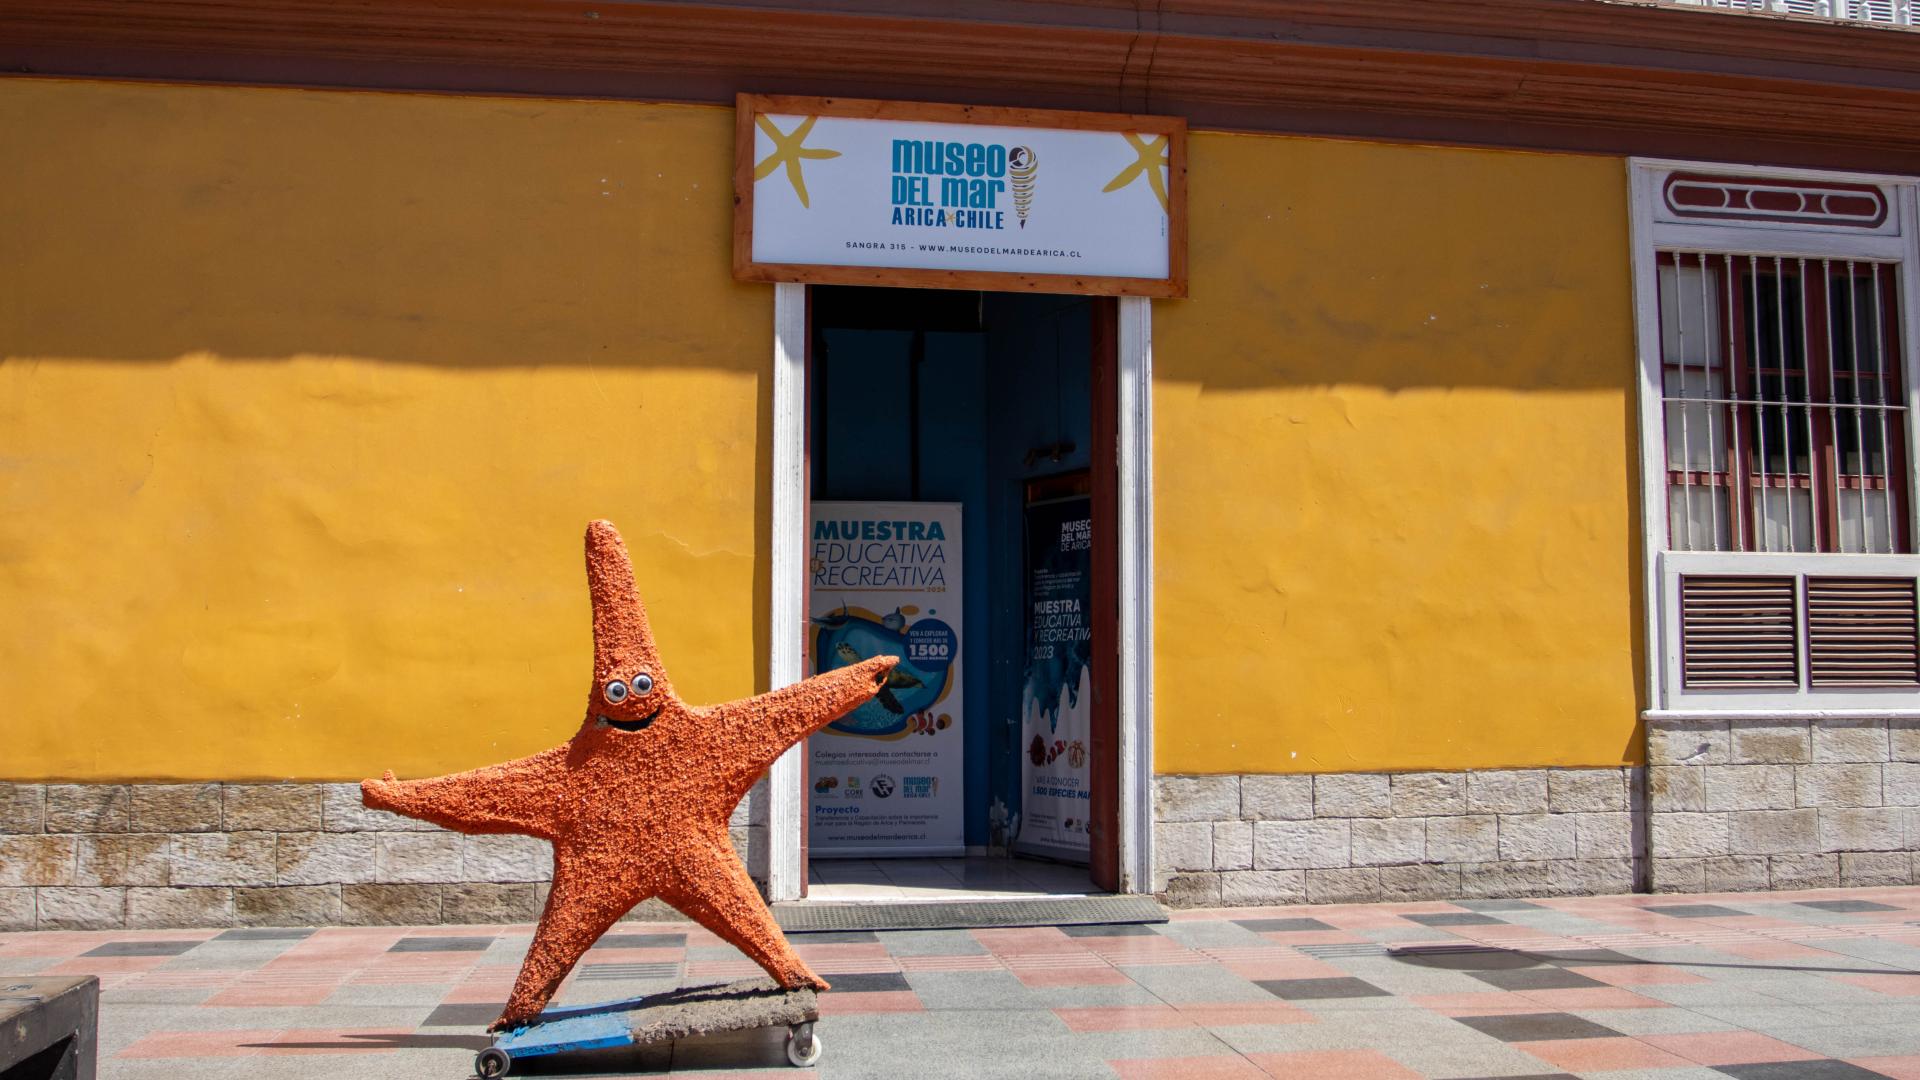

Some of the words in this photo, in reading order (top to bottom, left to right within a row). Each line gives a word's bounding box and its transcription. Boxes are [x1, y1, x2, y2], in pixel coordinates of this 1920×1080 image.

[893, 139, 1006, 178] museo
[892, 176, 934, 206] DEL
[941, 177, 1004, 208] mar
[892, 207, 947, 227] ARICA
[955, 210, 1004, 230] CHILE
[845, 241, 885, 250] SANGRA
[890, 243, 906, 251] 315
[919, 244, 1083, 258] WWW.MUSEODELMARDEARICA.CL
[814, 520, 946, 541] MUESTRA
[1061, 532, 1075, 543] DEL
[815, 543, 946, 564] EDUCATIVA
[1060, 542, 1070, 552] DE
[814, 566, 946, 586] RECREATIVA
[1034, 599, 1081, 615] MUESTRA
[1034, 614, 1082, 629] EDUCATIVA
[909, 644, 949, 656] 1500
[1034, 645, 1054, 660] 2023
[815, 750, 847, 760] Colegios
[1048, 787, 1076, 799] ESPECIES
[815, 804, 860, 816] Proyecto
